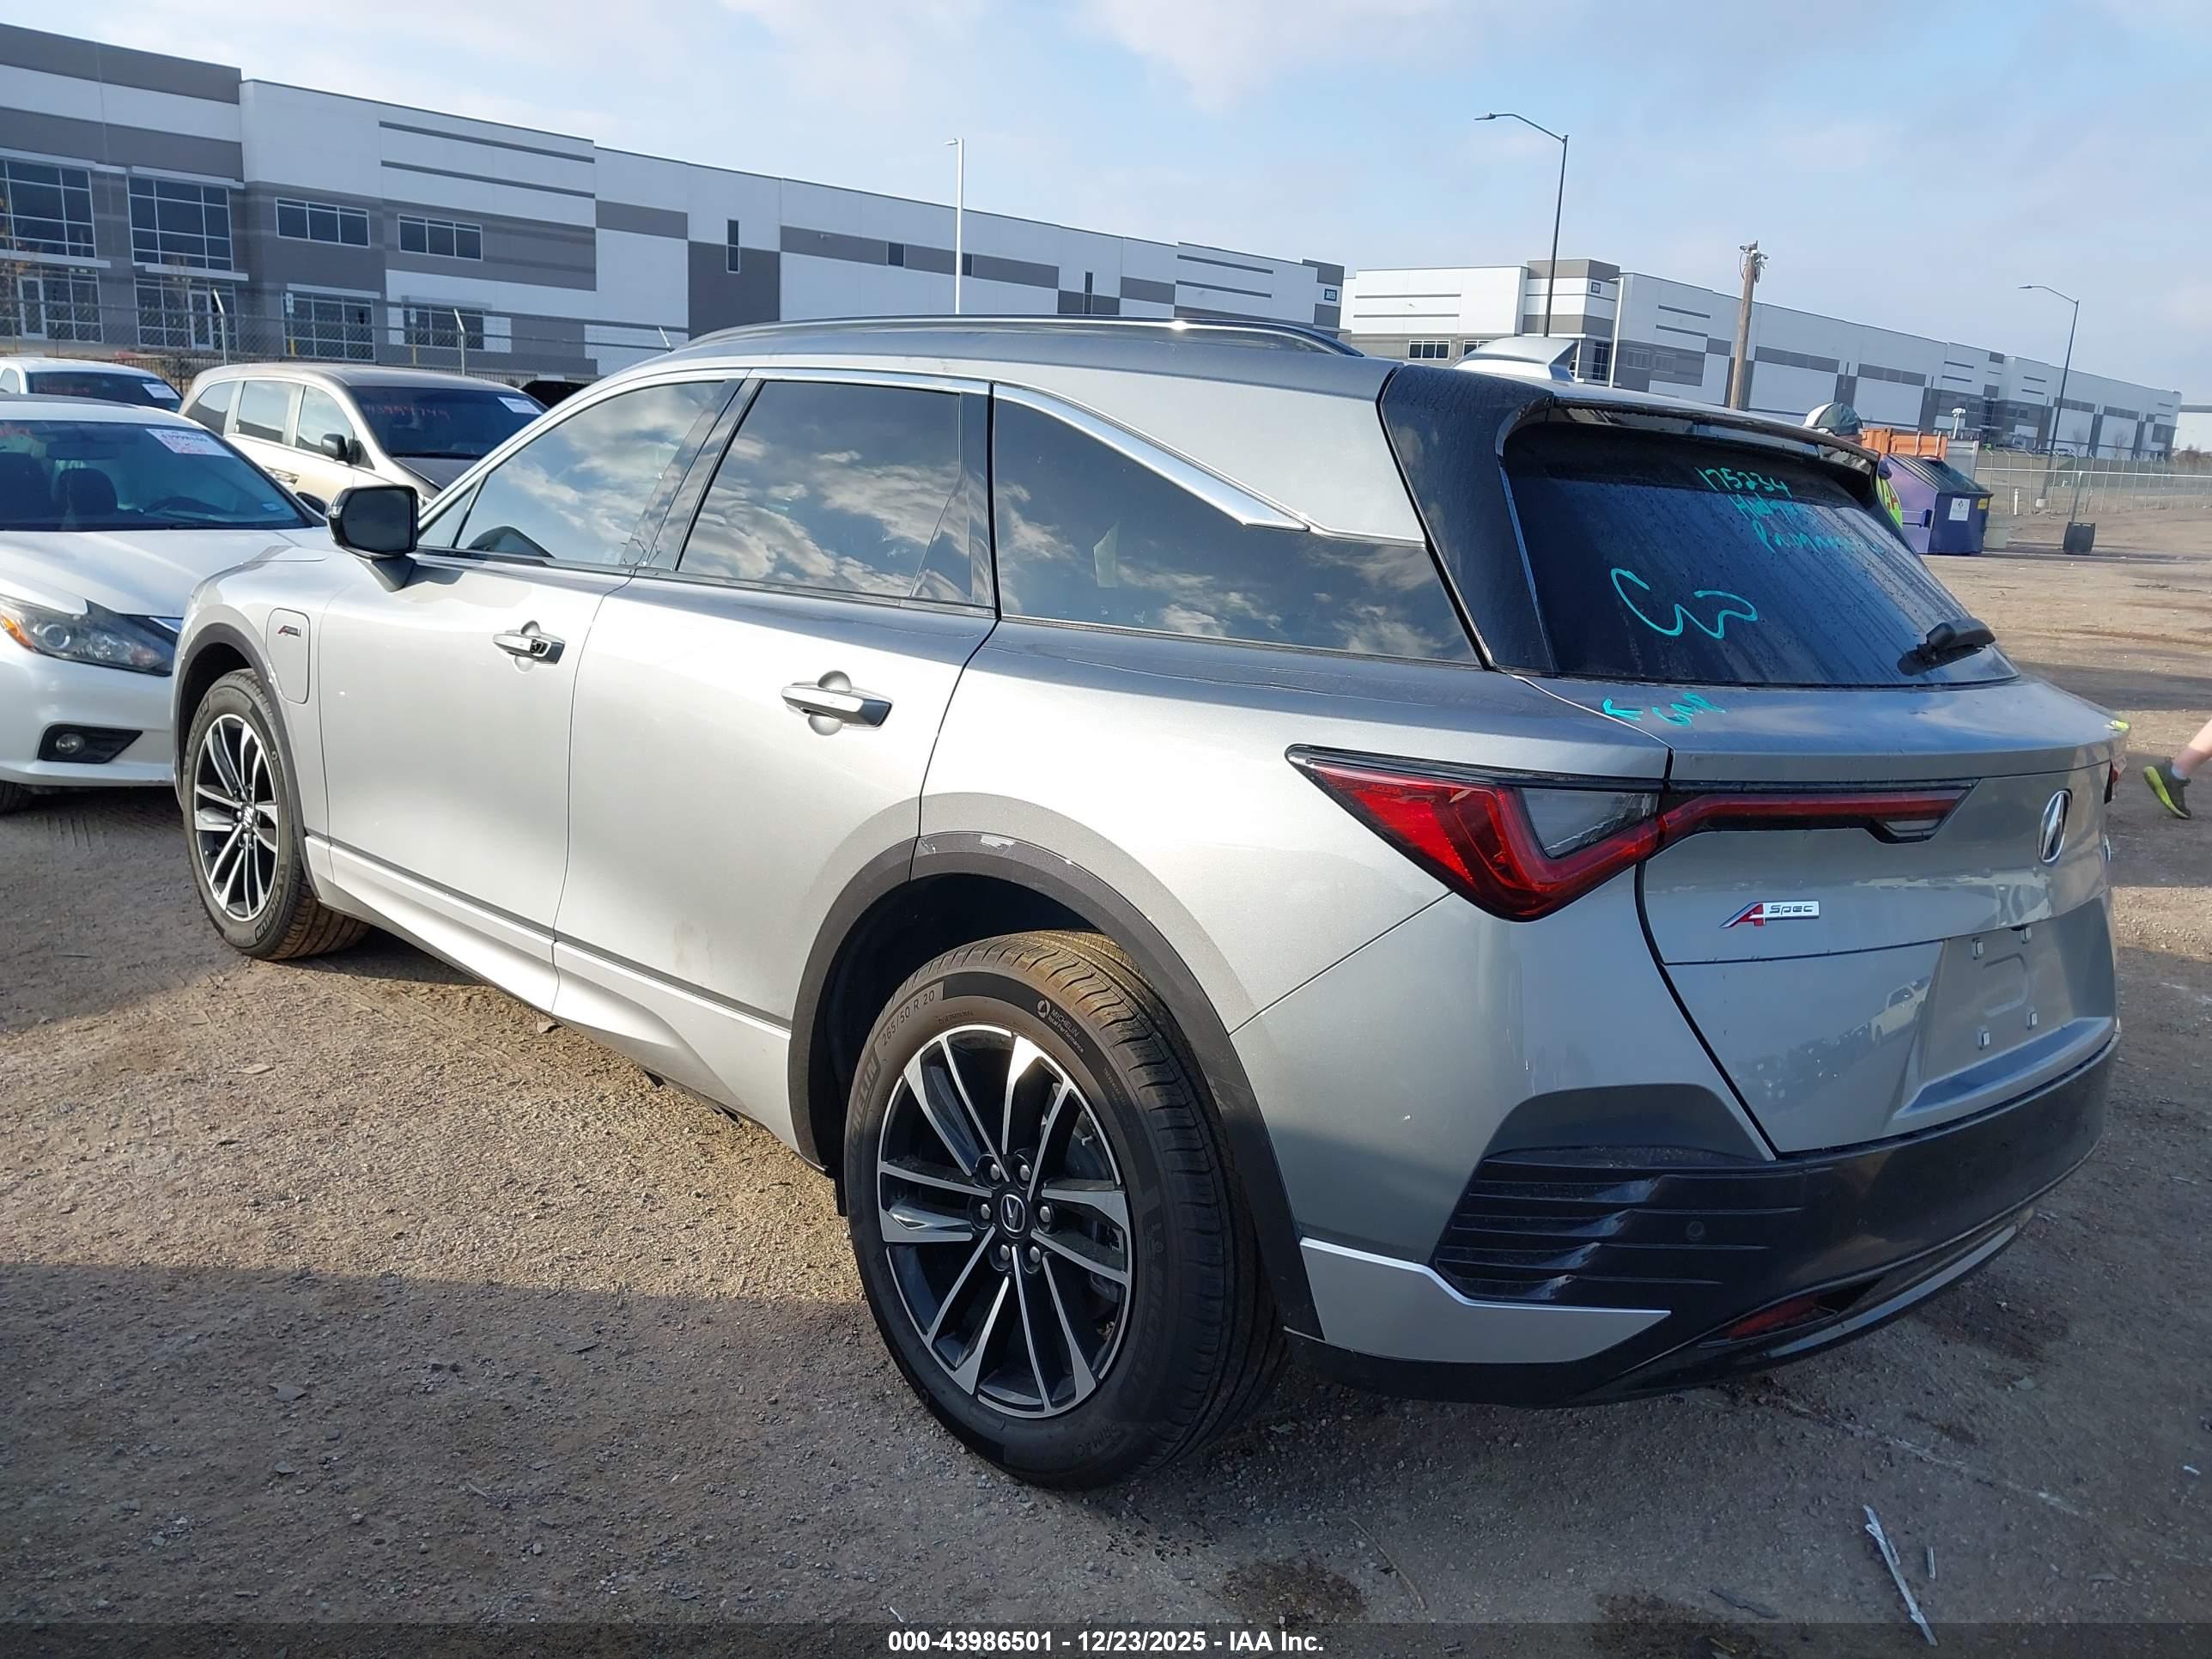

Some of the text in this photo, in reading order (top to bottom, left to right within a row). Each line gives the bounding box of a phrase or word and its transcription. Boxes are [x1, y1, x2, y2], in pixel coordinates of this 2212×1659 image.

[1694, 466, 1793, 498] 175234
[882, 989, 935, 1046] 265/50 R 20
[1050, 1008, 1079, 1037] MICHELIN
